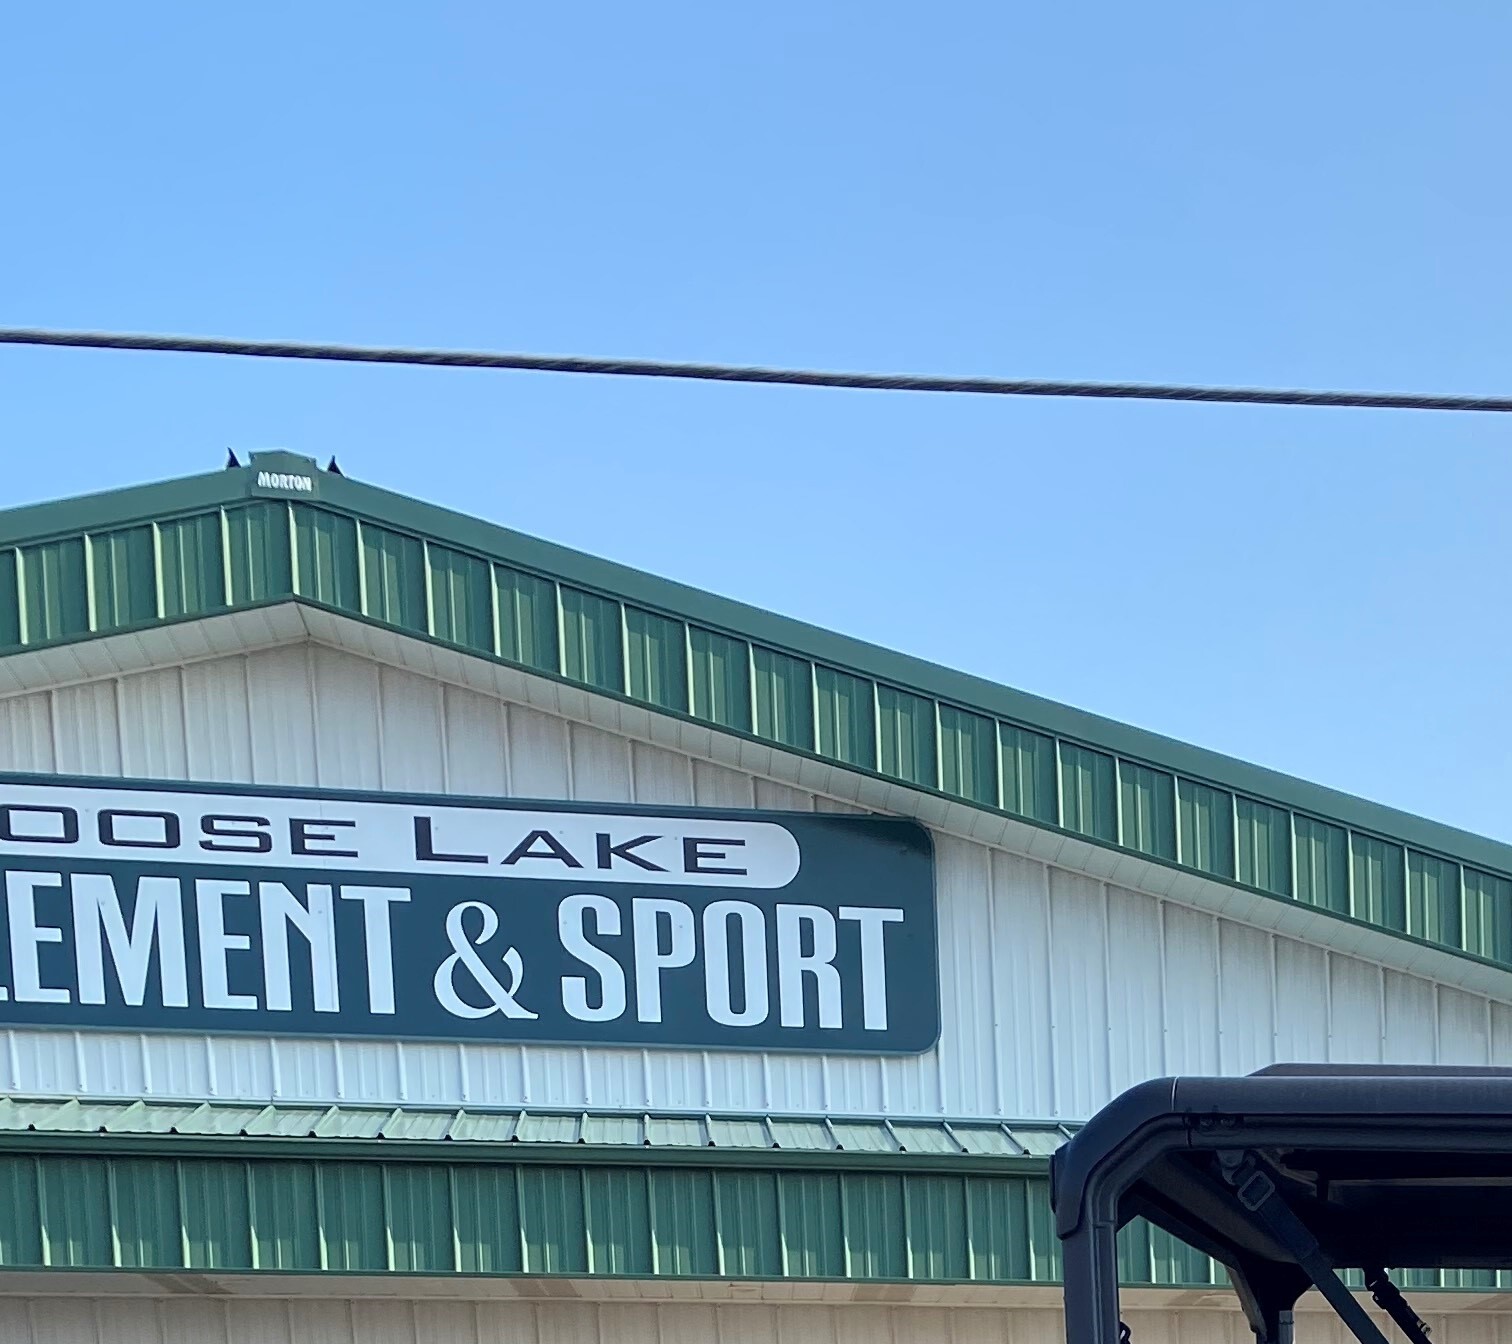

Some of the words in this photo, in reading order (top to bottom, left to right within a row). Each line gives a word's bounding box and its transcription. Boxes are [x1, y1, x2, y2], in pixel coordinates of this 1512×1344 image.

[257, 471, 312, 493] MORTON
[413, 816, 748, 876] LAKE
[0, 869, 412, 1016] EMENT
[433, 900, 539, 1020] &
[558, 893, 905, 1032] SPORT
